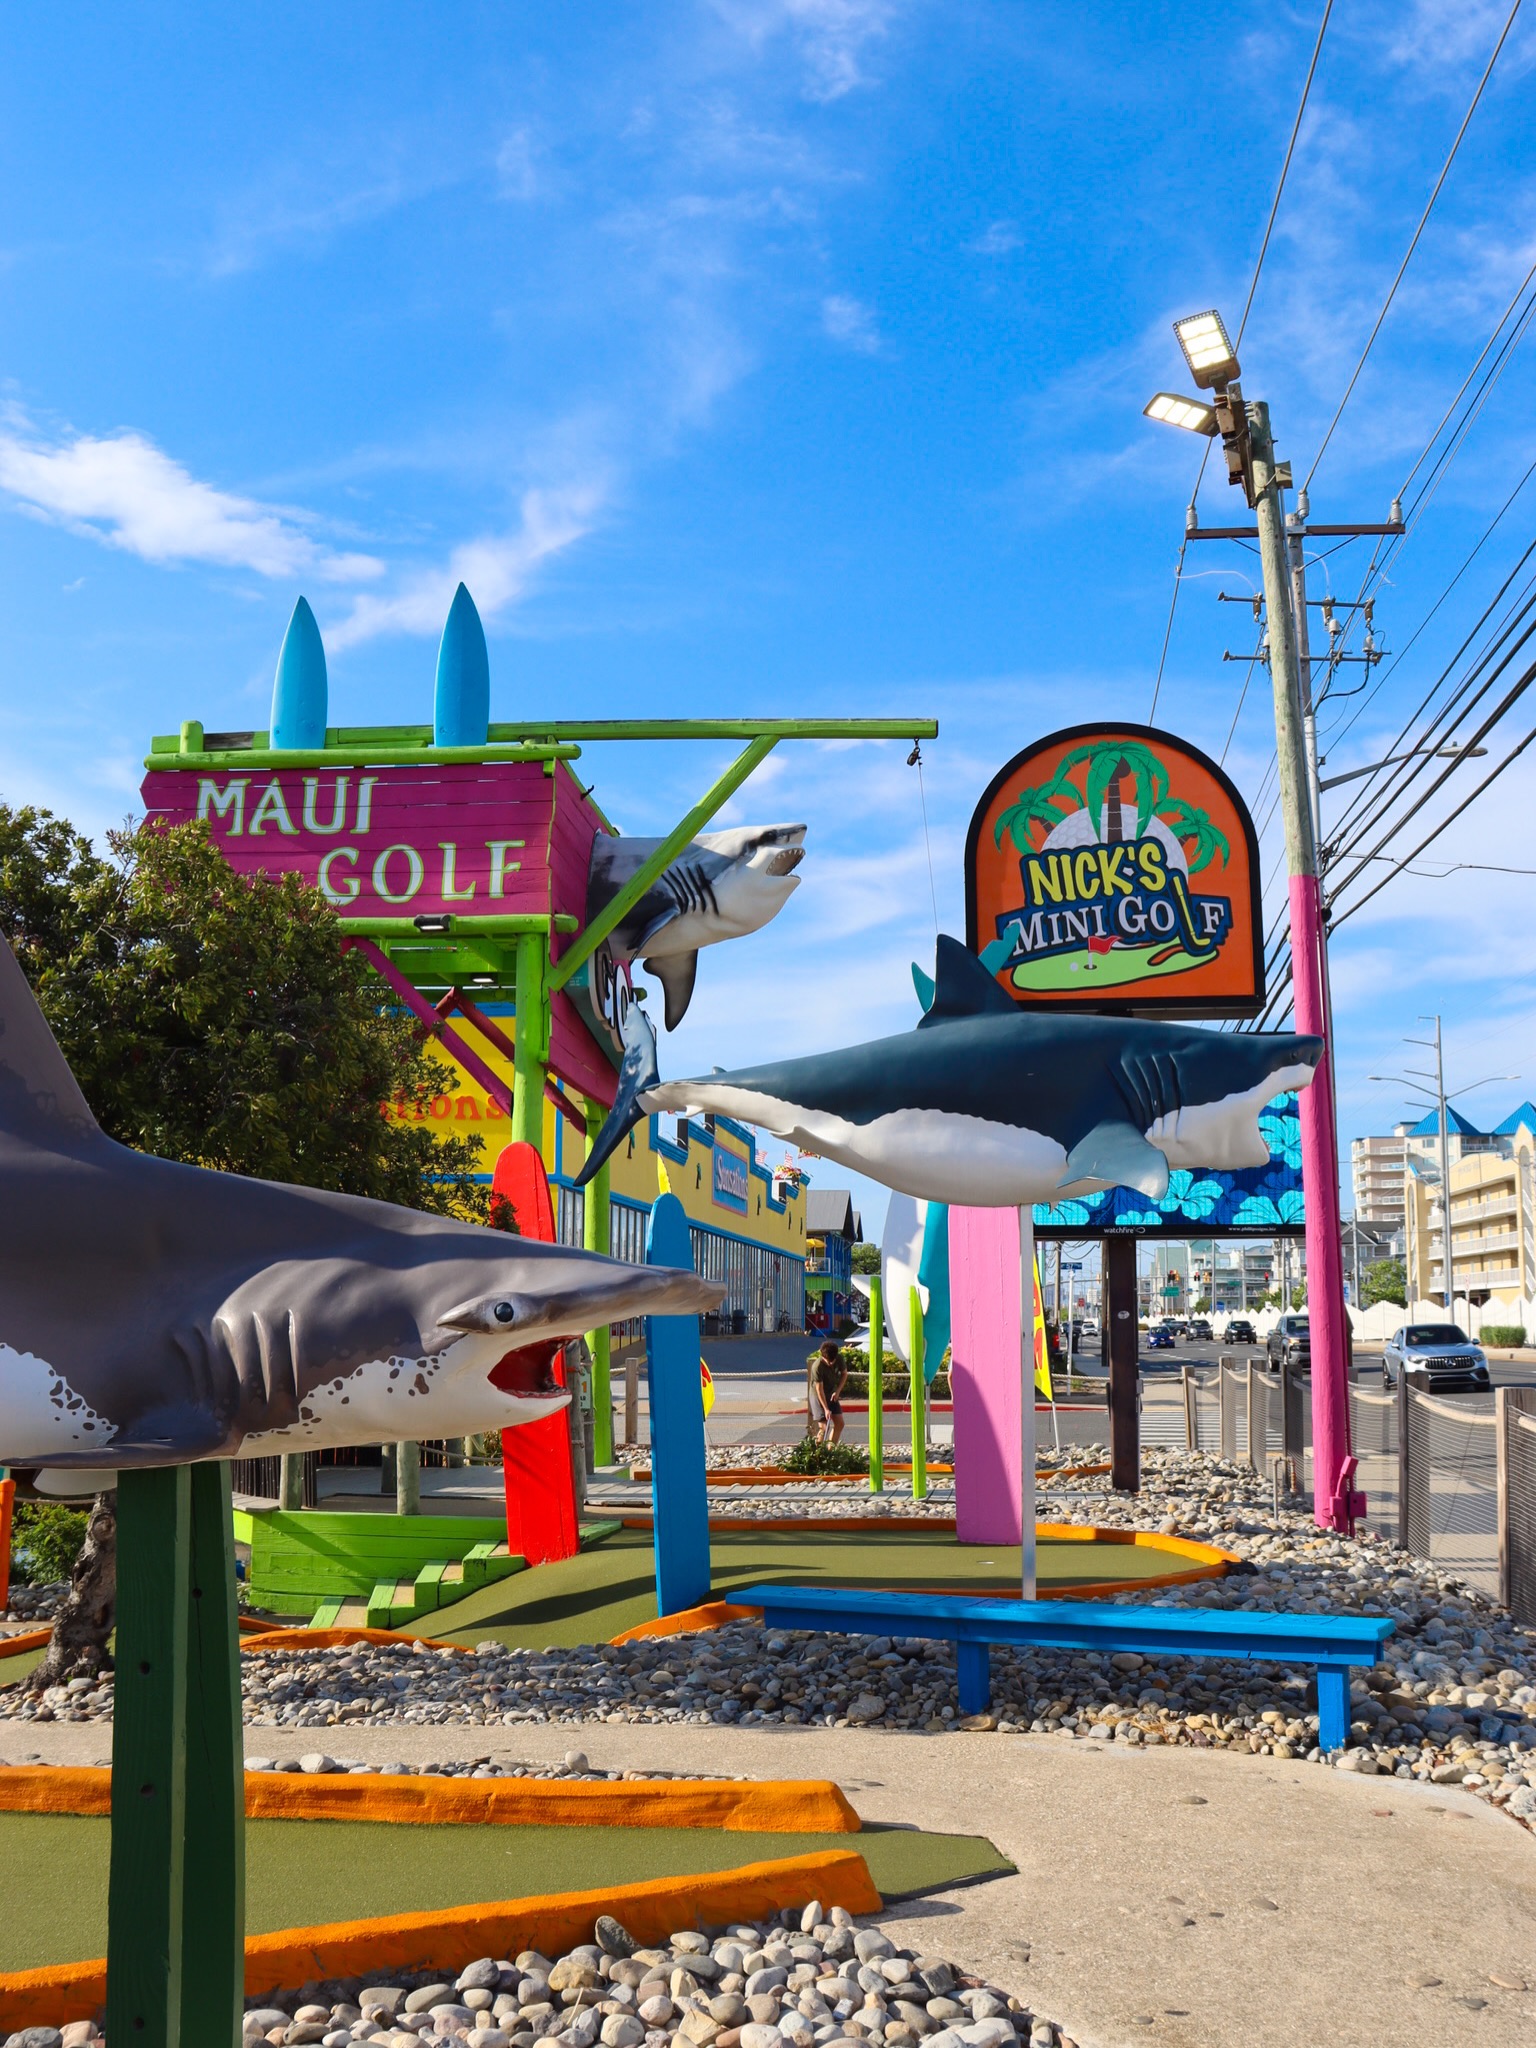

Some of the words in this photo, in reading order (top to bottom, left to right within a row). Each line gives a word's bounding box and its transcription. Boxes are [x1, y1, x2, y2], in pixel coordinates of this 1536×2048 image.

[196, 776, 379, 836] MAUI
[317, 840, 526, 906] GOLF
[1027, 842, 1167, 906] NICK'S
[1008, 905, 1107, 956] MINI
